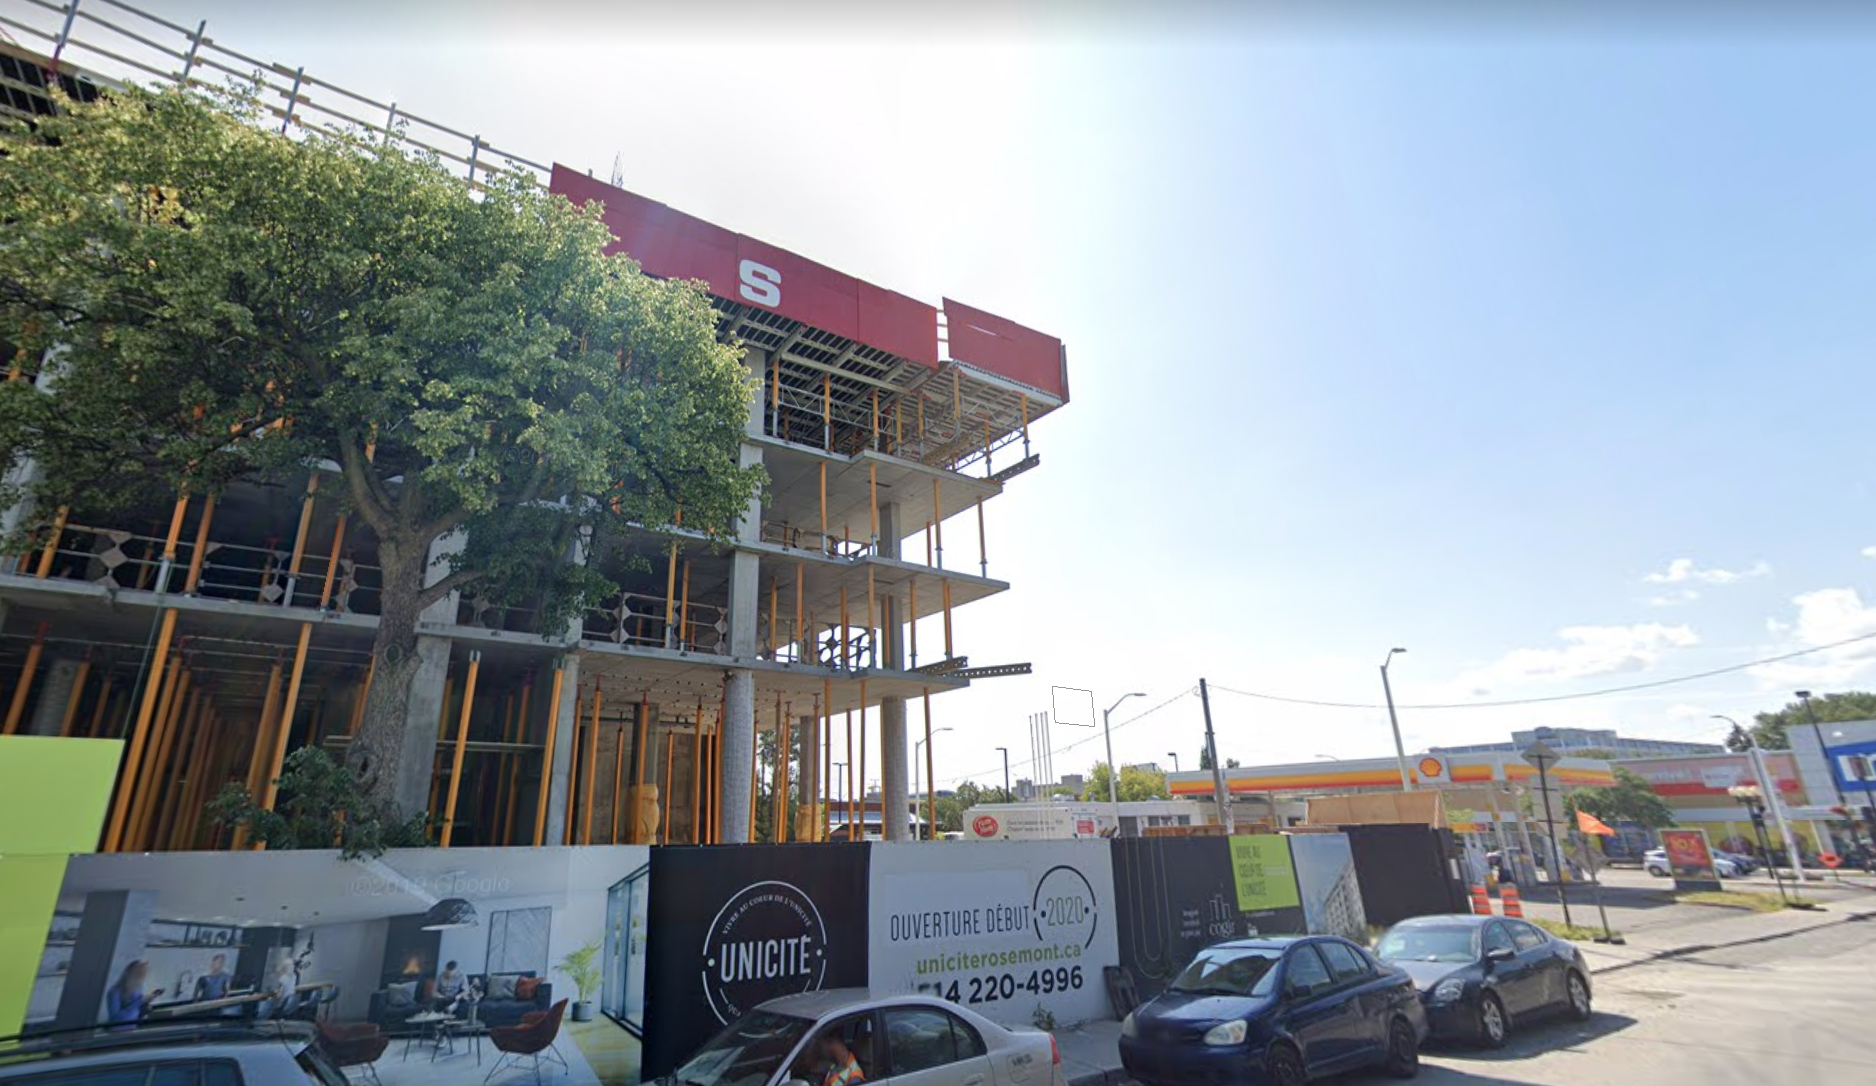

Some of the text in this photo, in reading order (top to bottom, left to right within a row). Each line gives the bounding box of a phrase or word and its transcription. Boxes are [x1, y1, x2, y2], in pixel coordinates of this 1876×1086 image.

[739, 259, 782, 308] S
[722, 911, 740, 934] VIVRE
[739, 902, 749, 914] AU
[774, 894, 784, 903] DE
[890, 895, 1084, 942] OUVERTURE DÉBUT 2020
[720, 934, 812, 982] UNICITÉ
[916, 943, 1082, 975] uniciterosemont.ca
[968, 965, 1084, 1005] 220-4996
